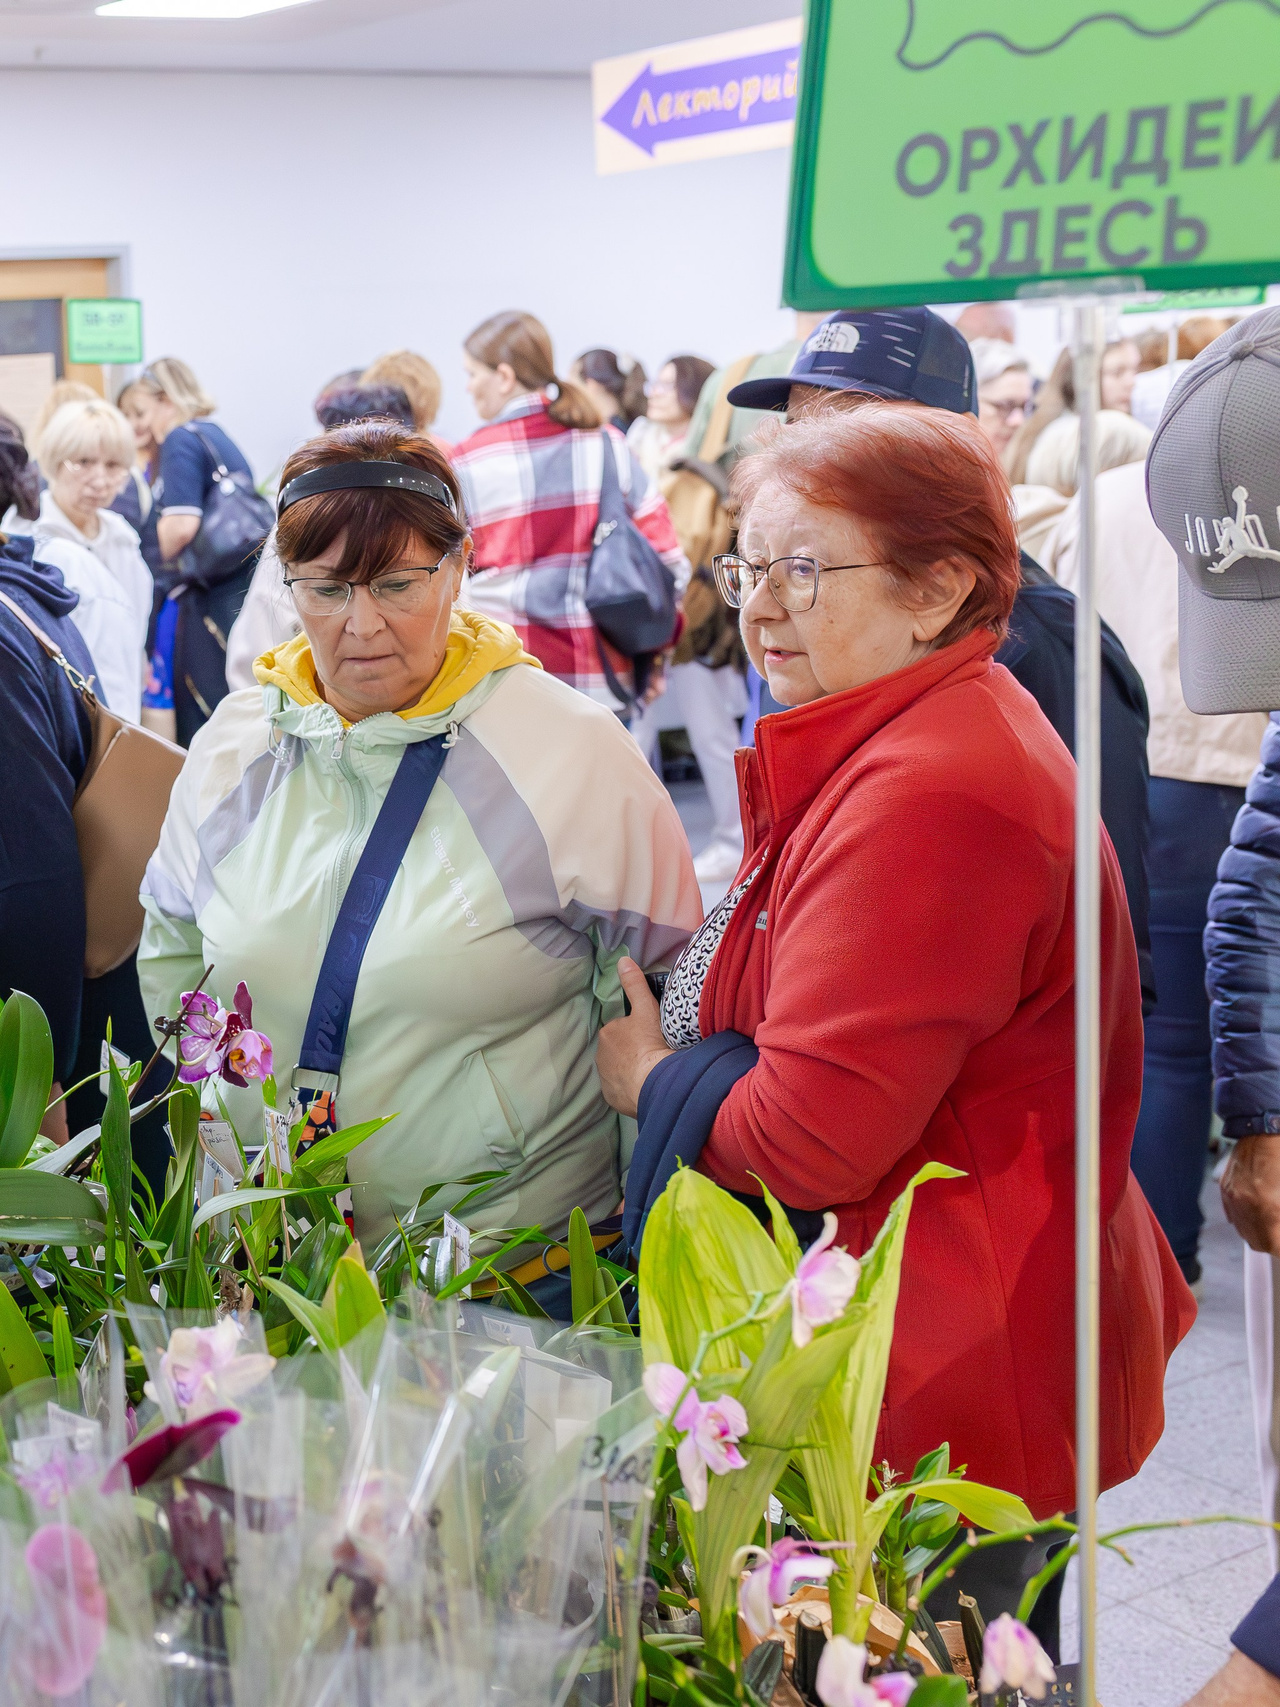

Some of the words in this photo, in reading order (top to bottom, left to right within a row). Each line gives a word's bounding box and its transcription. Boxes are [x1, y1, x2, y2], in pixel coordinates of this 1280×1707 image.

[631, 57, 799, 128] Лекторий
[895, 91, 1280, 198] ОРХИДЕИ
[943, 195, 1209, 279] ЗДЕСЬ
[430, 825, 455, 875] Elegant
[449, 877, 480, 928] Monkey
